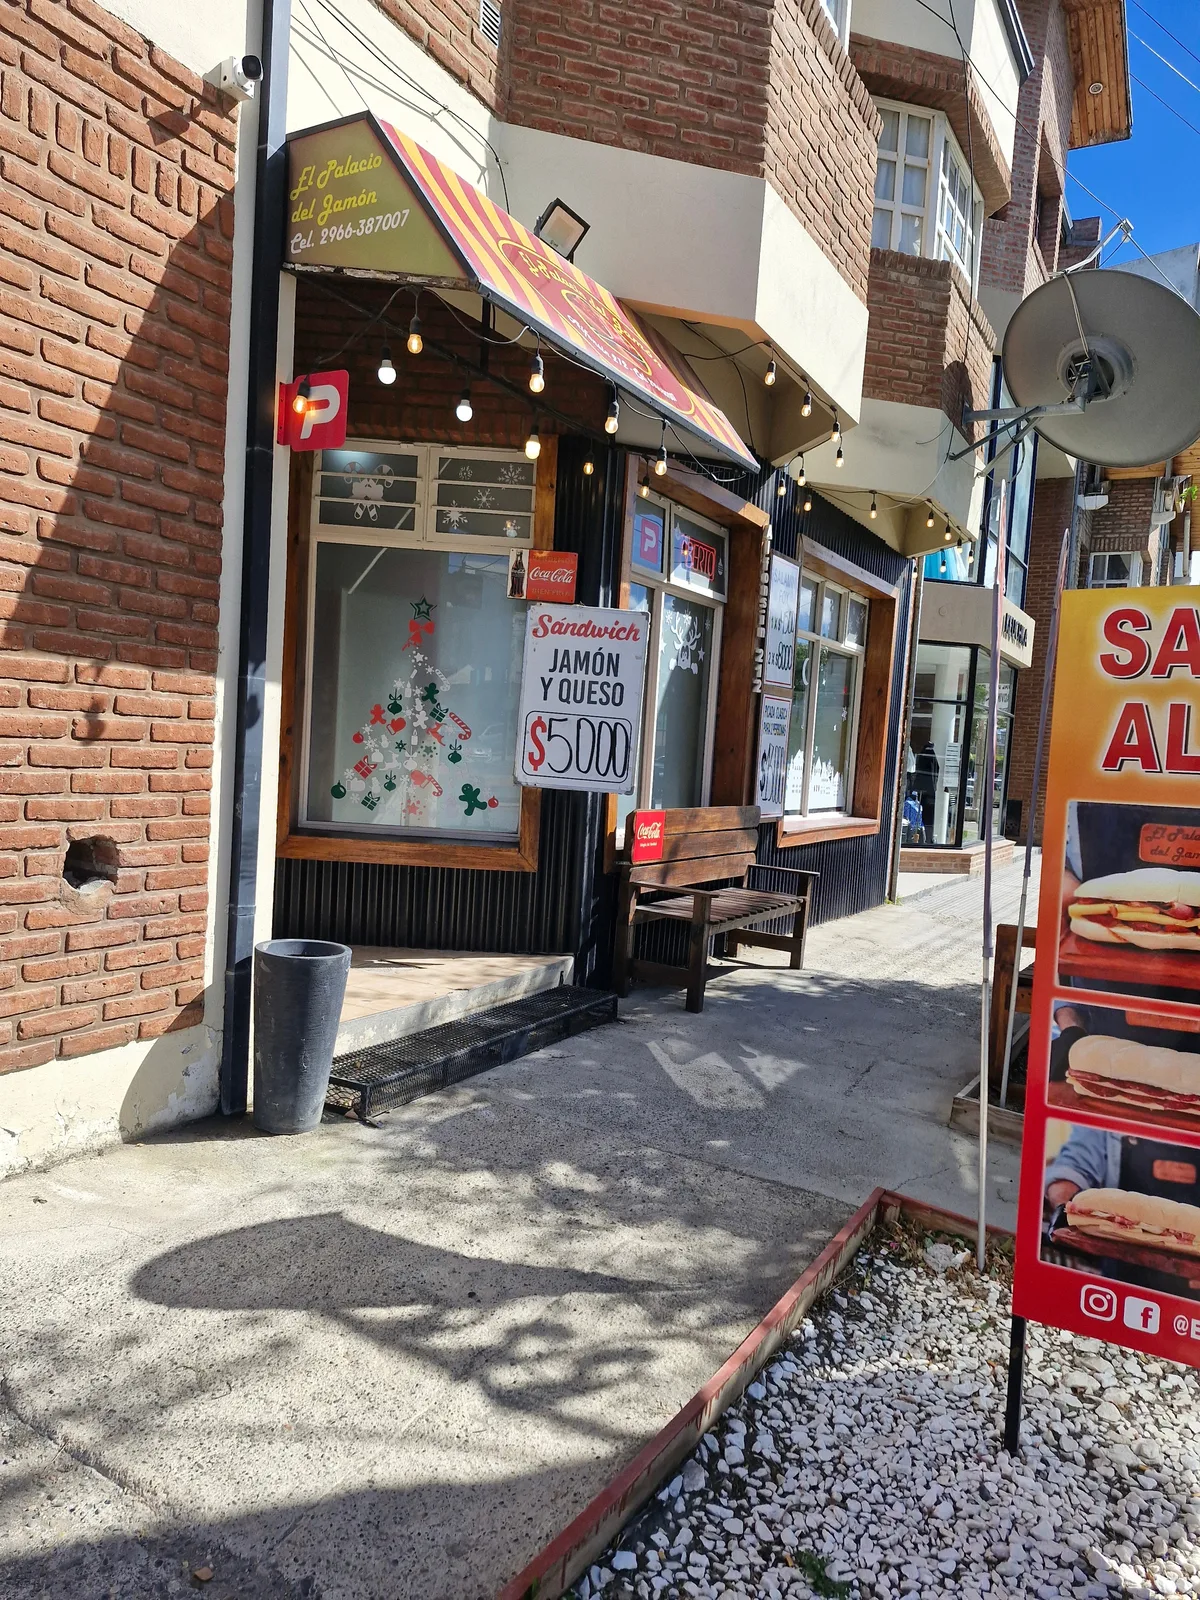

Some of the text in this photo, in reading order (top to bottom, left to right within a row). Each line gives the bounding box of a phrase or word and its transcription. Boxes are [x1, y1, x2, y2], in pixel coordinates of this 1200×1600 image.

[290, 152, 383, 201] El Palacio
[292, 188, 377, 227] del Jamón
[290, 208, 410, 254] Cel. 2966-387007
[529, 566, 575, 584] Coca-Cola
[532, 613, 641, 642] Sándwich
[1099, 608, 1200, 680] SA
[548, 646, 620, 678] JAMÓN
[540, 676, 625, 707] Y QUESO
[528, 715, 630, 778] $5000
[1101, 702, 1200, 776] AL
